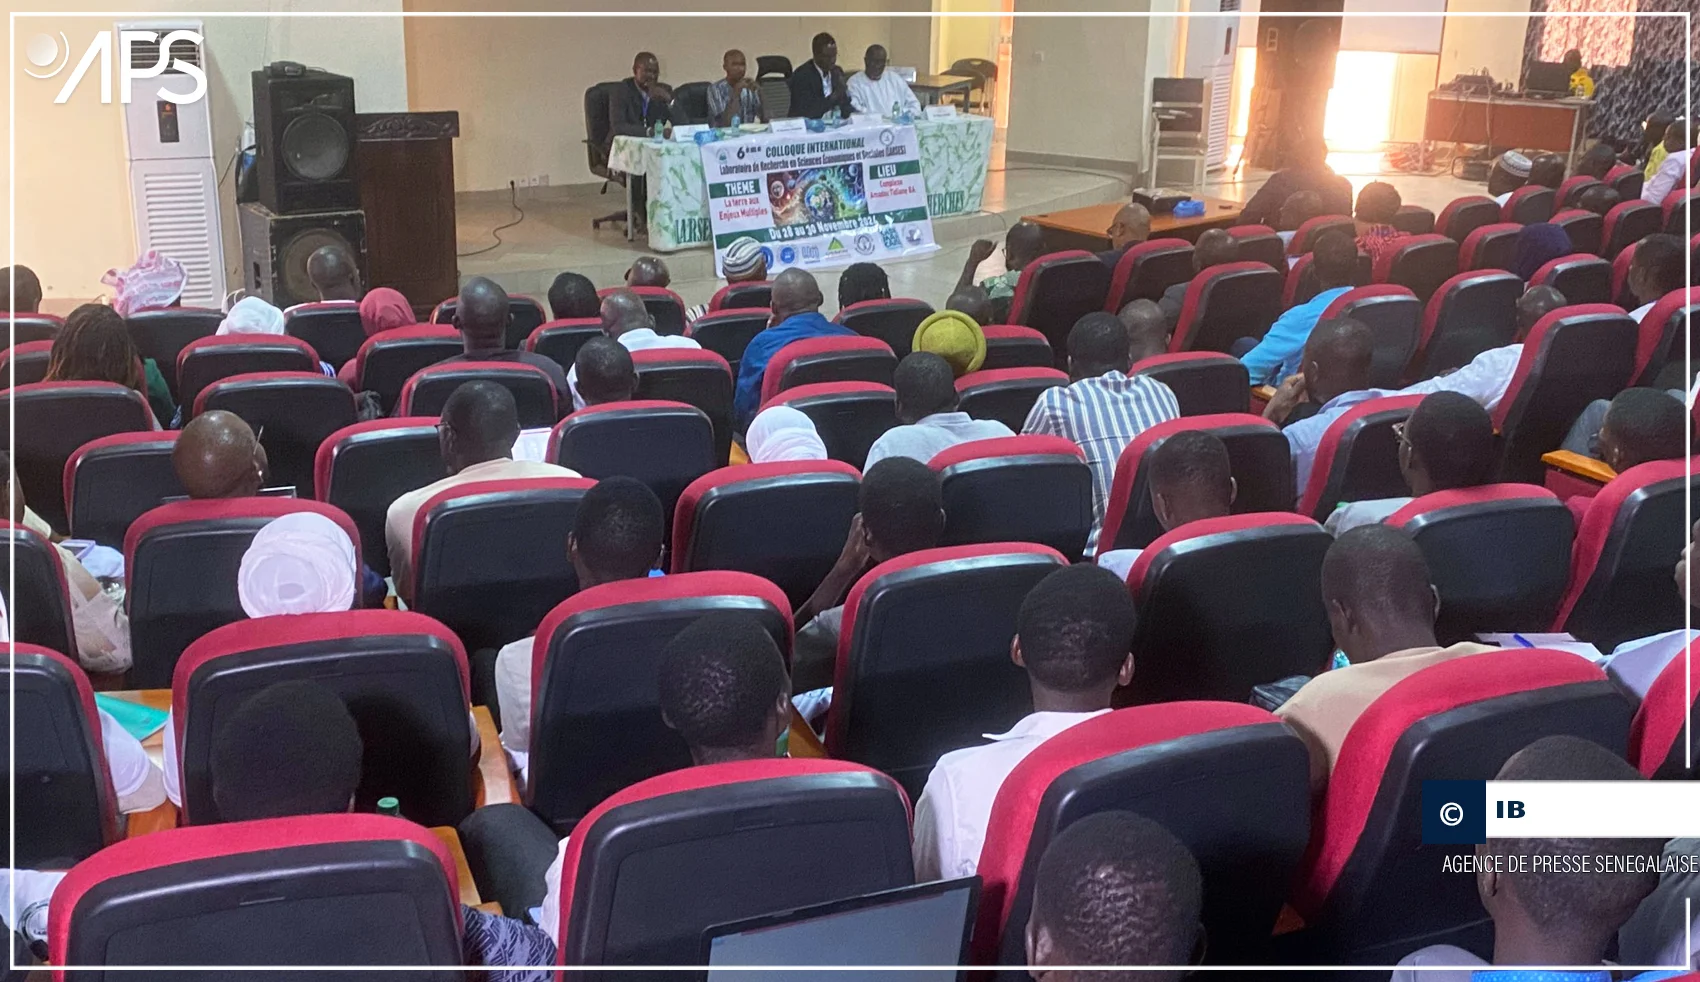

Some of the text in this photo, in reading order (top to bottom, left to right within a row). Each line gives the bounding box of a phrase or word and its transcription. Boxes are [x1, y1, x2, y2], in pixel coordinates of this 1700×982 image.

[766, 144, 805, 158] COLLOQUE
[807, 137, 865, 154] INTERNATIONAL
[720, 162, 752, 175] Laboratoire
[753, 161, 760, 172] de
[760, 158, 789, 171] Recherche
[790, 158, 797, 168] en
[797, 154, 822, 169] Sciences
[856, 151, 862, 160] et
[877, 163, 897, 178] LIEU
[725, 180, 755, 196] THEME
[724, 197, 759, 208] La terre aux
[719, 207, 767, 221] Enjeux Multiples
[769, 226, 781, 240] Du
[782, 224, 794, 238] 28
[794, 225, 805, 237] au
[806, 222, 817, 236] 30
[817, 218, 858, 234] Novembre
